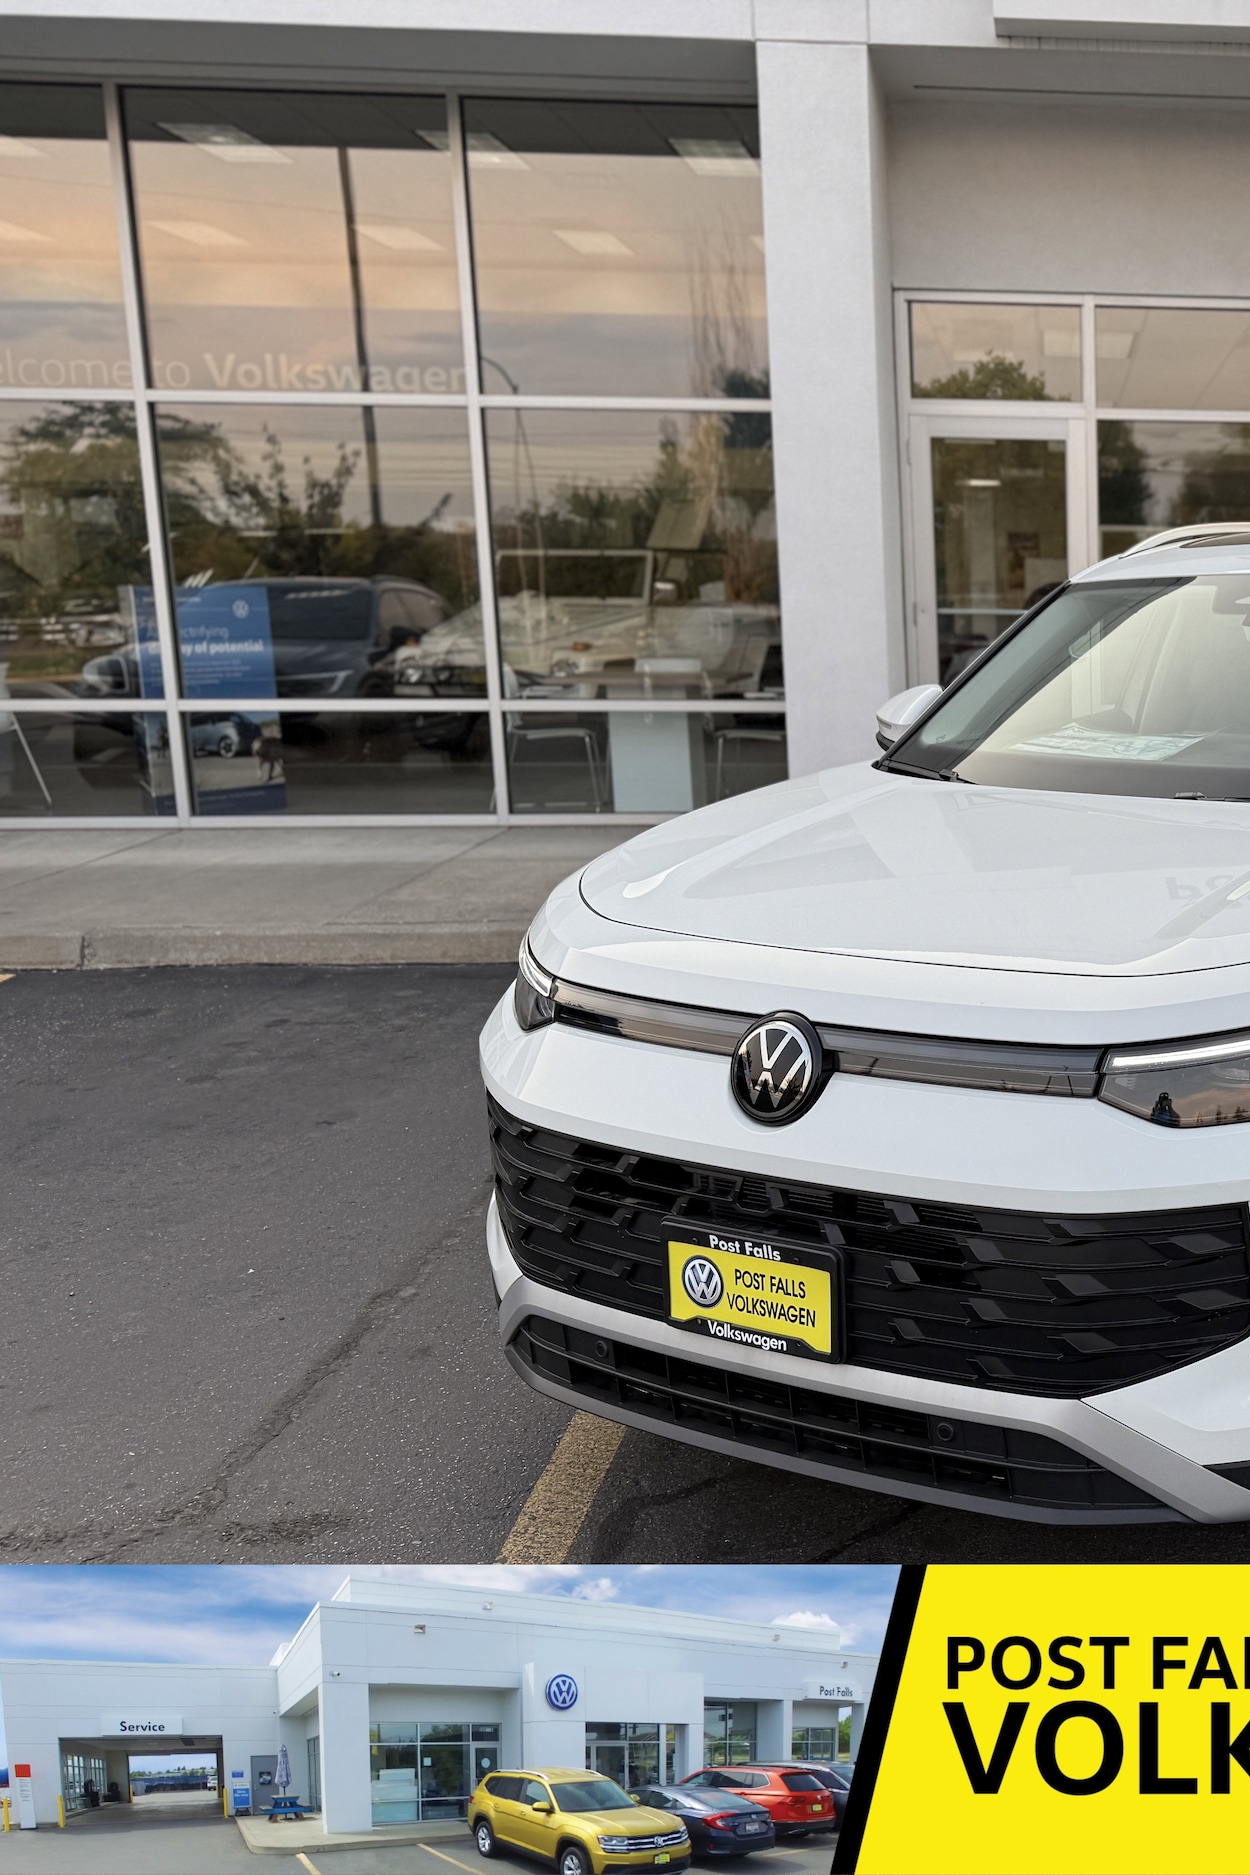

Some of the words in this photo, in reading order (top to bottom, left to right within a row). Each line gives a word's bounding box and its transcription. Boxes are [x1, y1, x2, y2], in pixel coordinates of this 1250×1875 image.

[0, 349, 132, 387] lcome
[709, 1235, 741, 1255] Post
[744, 1242, 781, 1262] Falls
[735, 1268, 766, 1291] POST
[769, 1276, 806, 1299] FALLS
[727, 1292, 816, 1329] VOLKSWAGEN
[708, 1320, 787, 1351] Volkswagen
